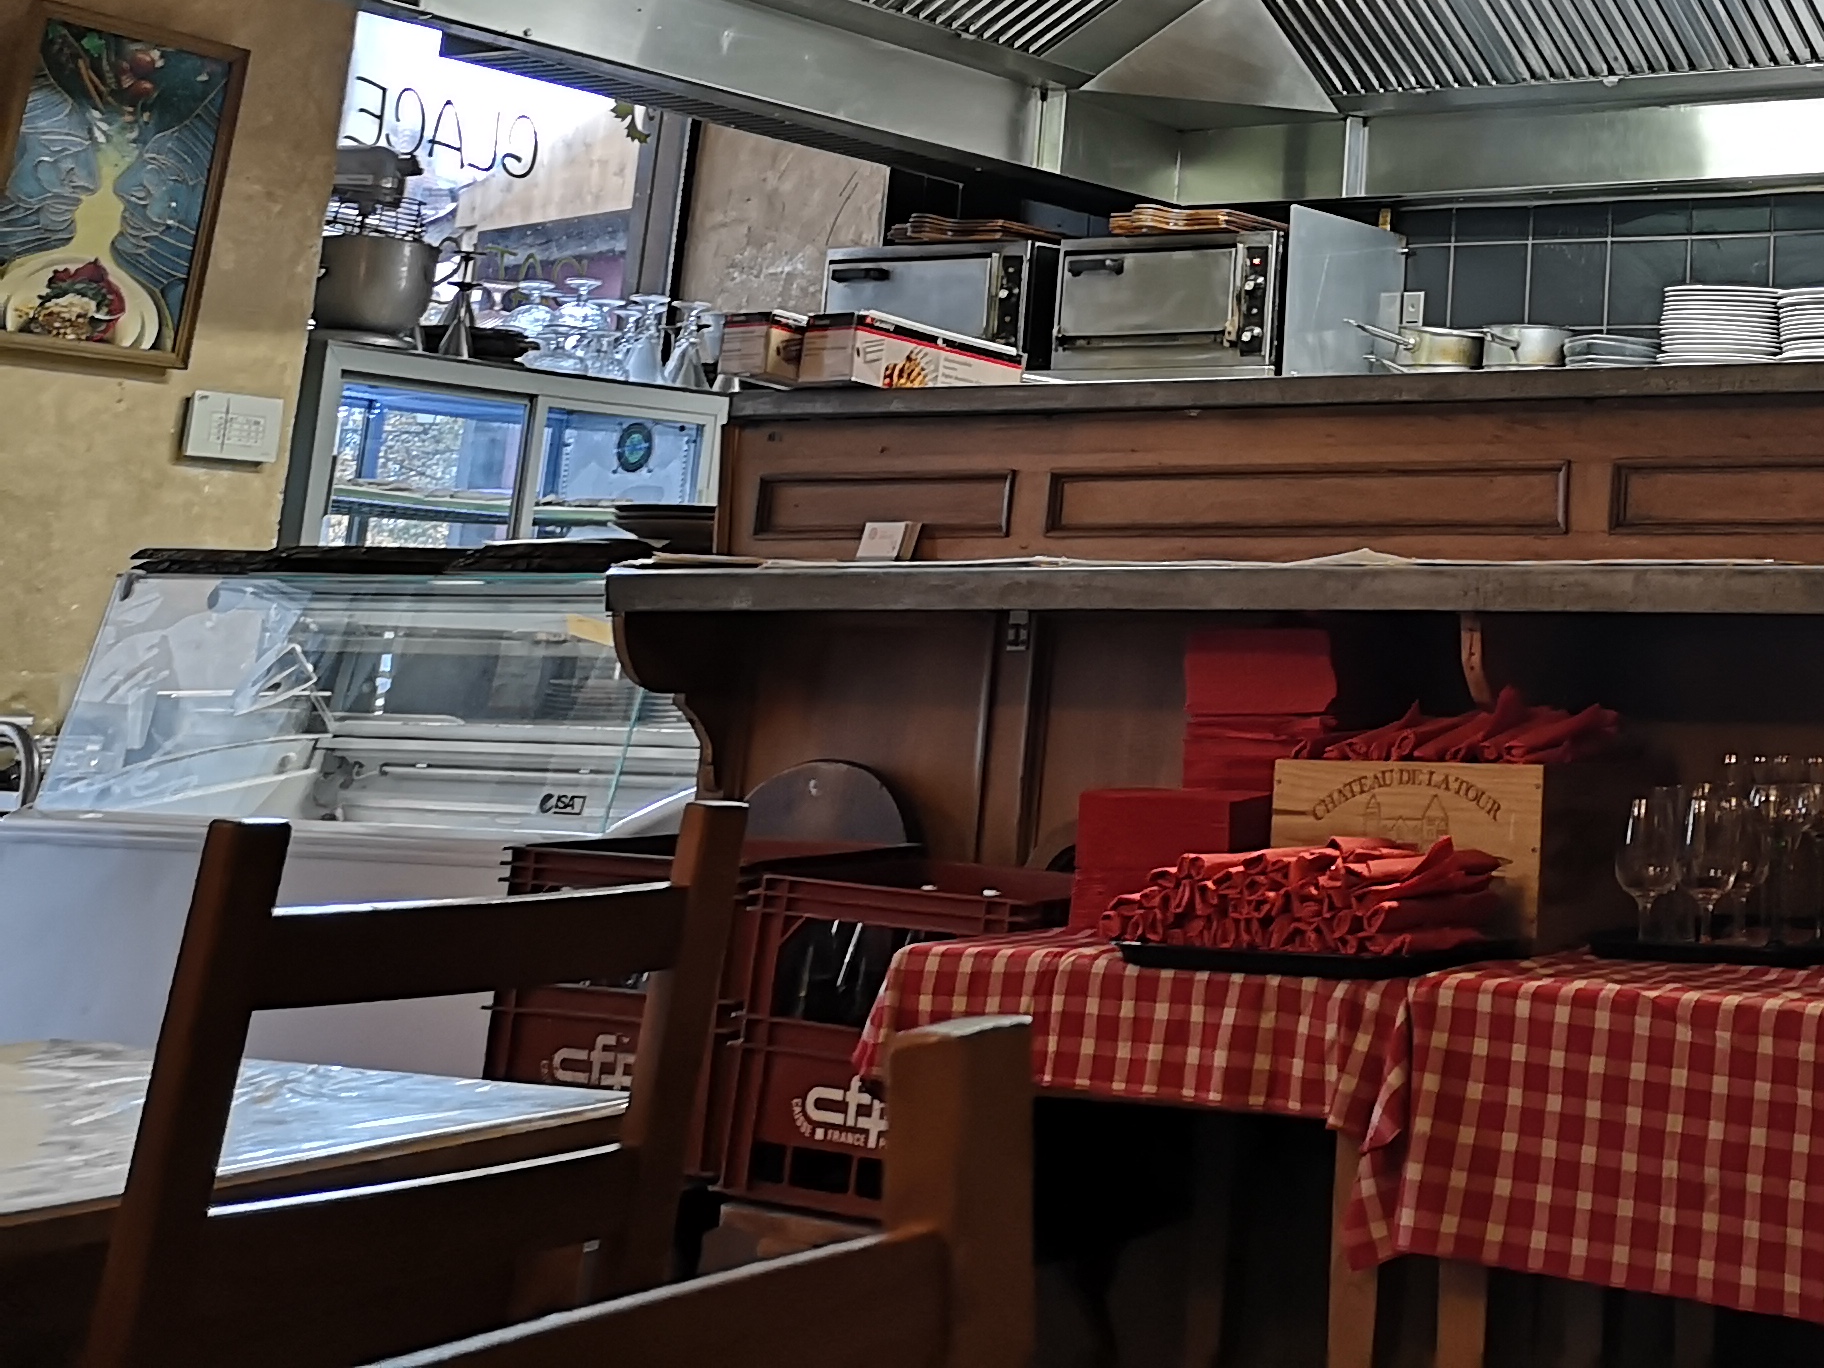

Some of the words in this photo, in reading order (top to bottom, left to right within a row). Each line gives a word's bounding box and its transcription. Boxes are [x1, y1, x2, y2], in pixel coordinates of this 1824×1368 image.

[1312, 768, 1395, 821] CHATEAU
[1398, 768, 1422, 786] DE
[1426, 770, 1452, 792] LA
[1453, 776, 1502, 822] TOUR
